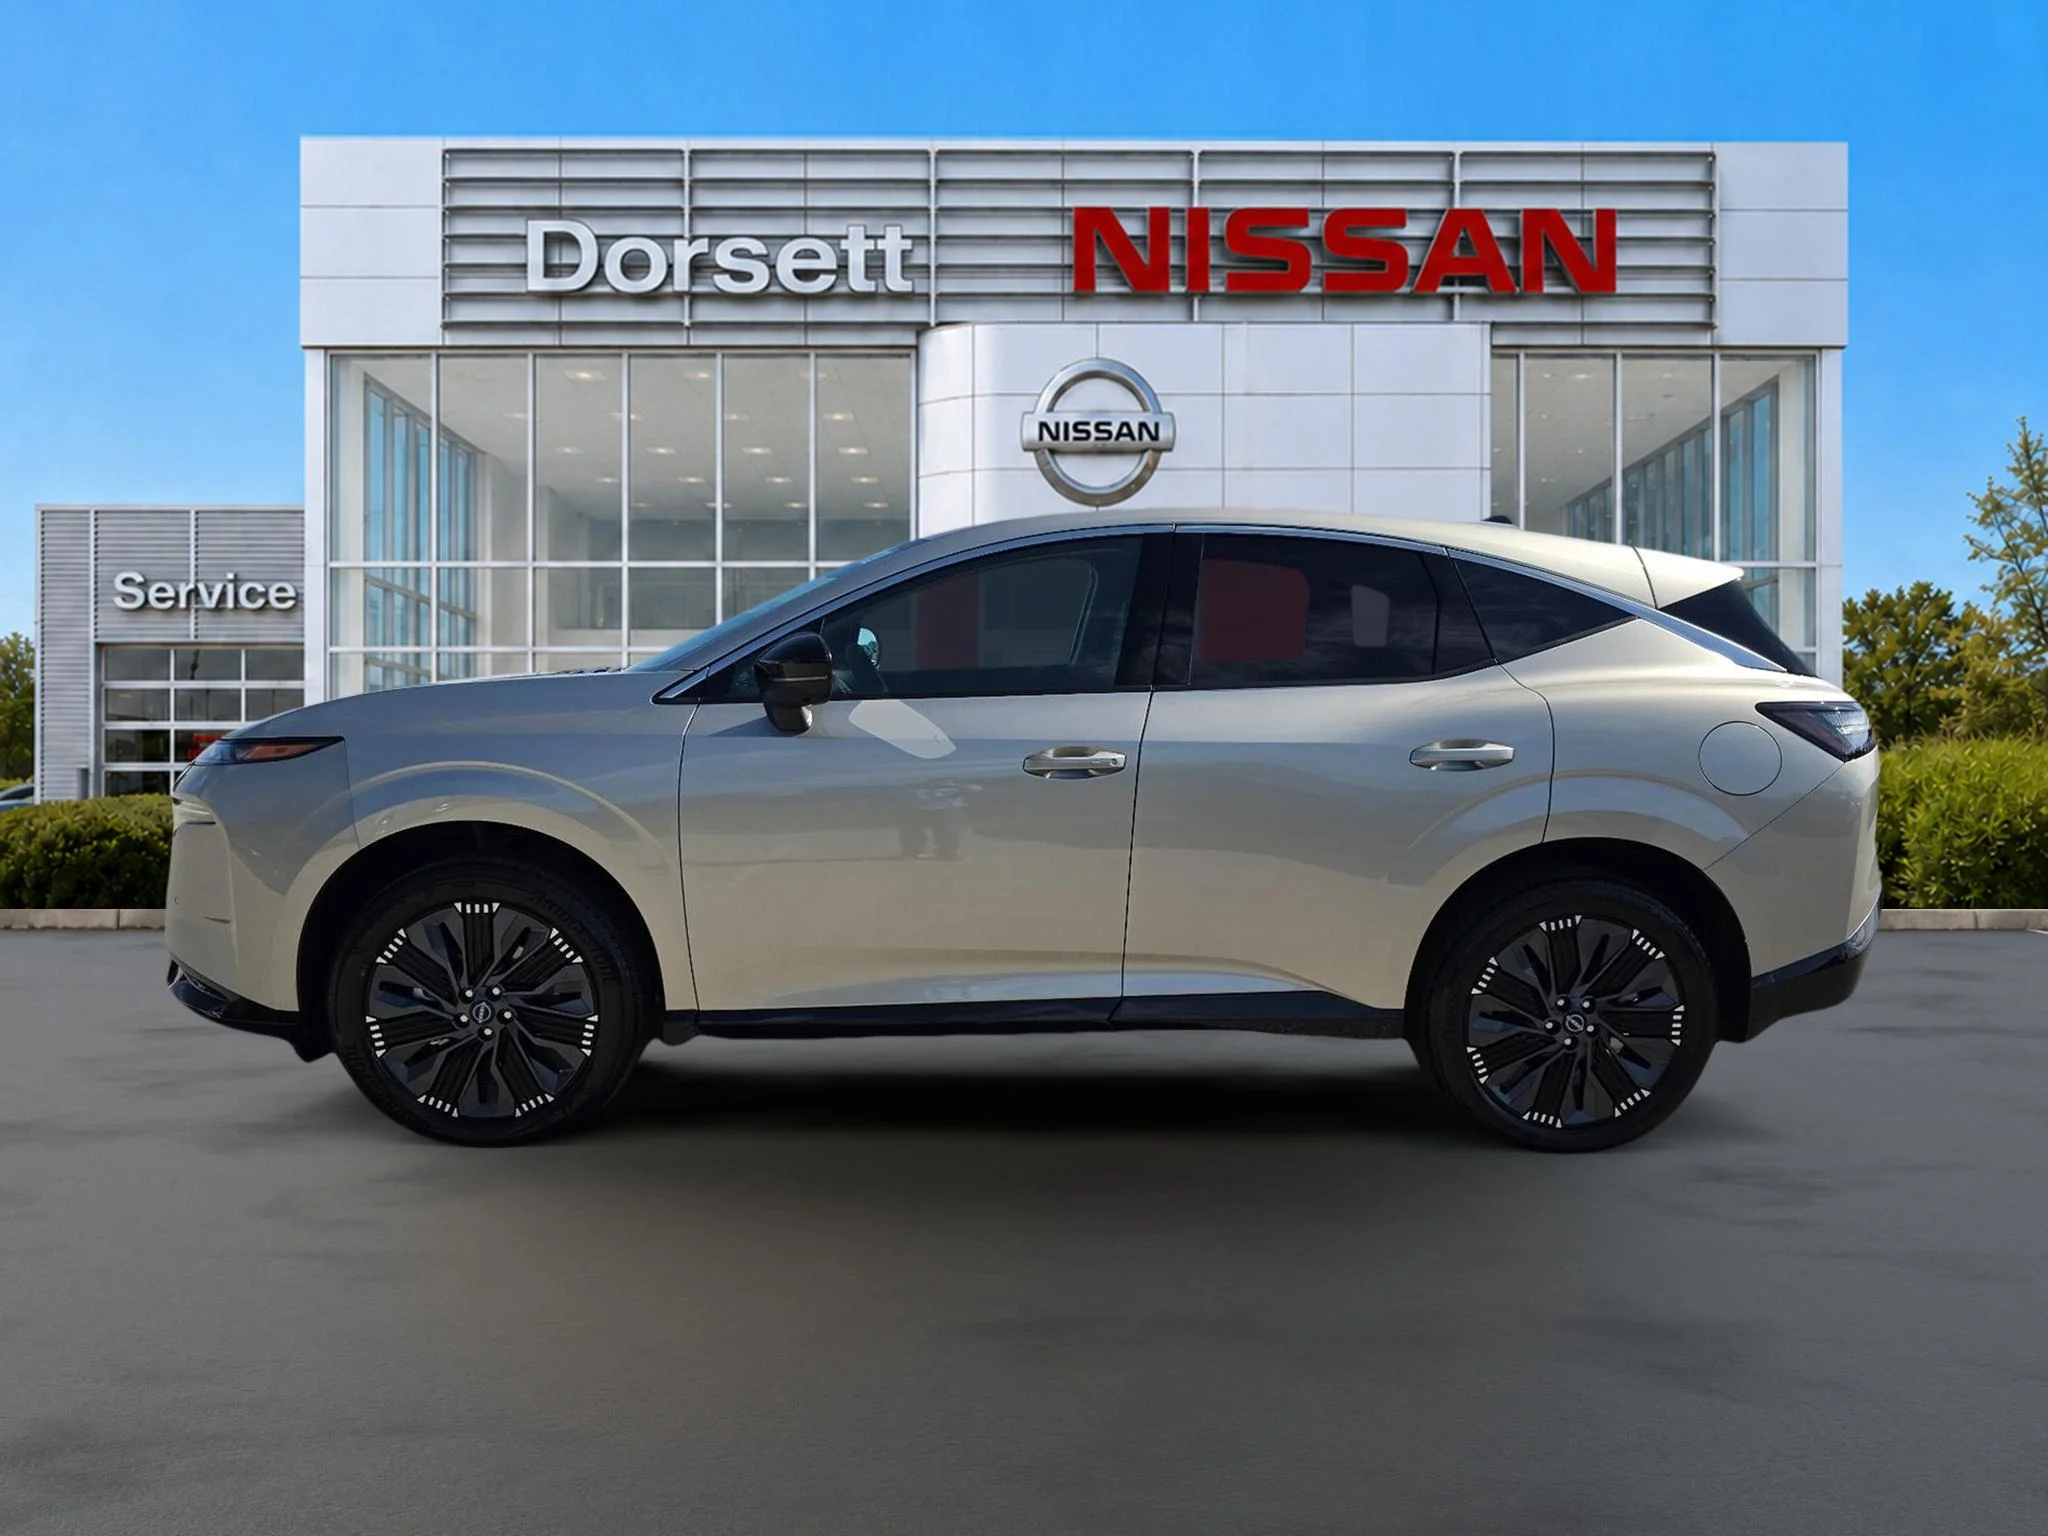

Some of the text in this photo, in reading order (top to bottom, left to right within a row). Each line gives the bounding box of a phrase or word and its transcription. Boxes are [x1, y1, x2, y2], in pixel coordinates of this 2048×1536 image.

[526, 207, 1617, 294] Dorsett NISSAN
[1038, 421, 1160, 442] NISSAN
[113, 571, 298, 610] Service
